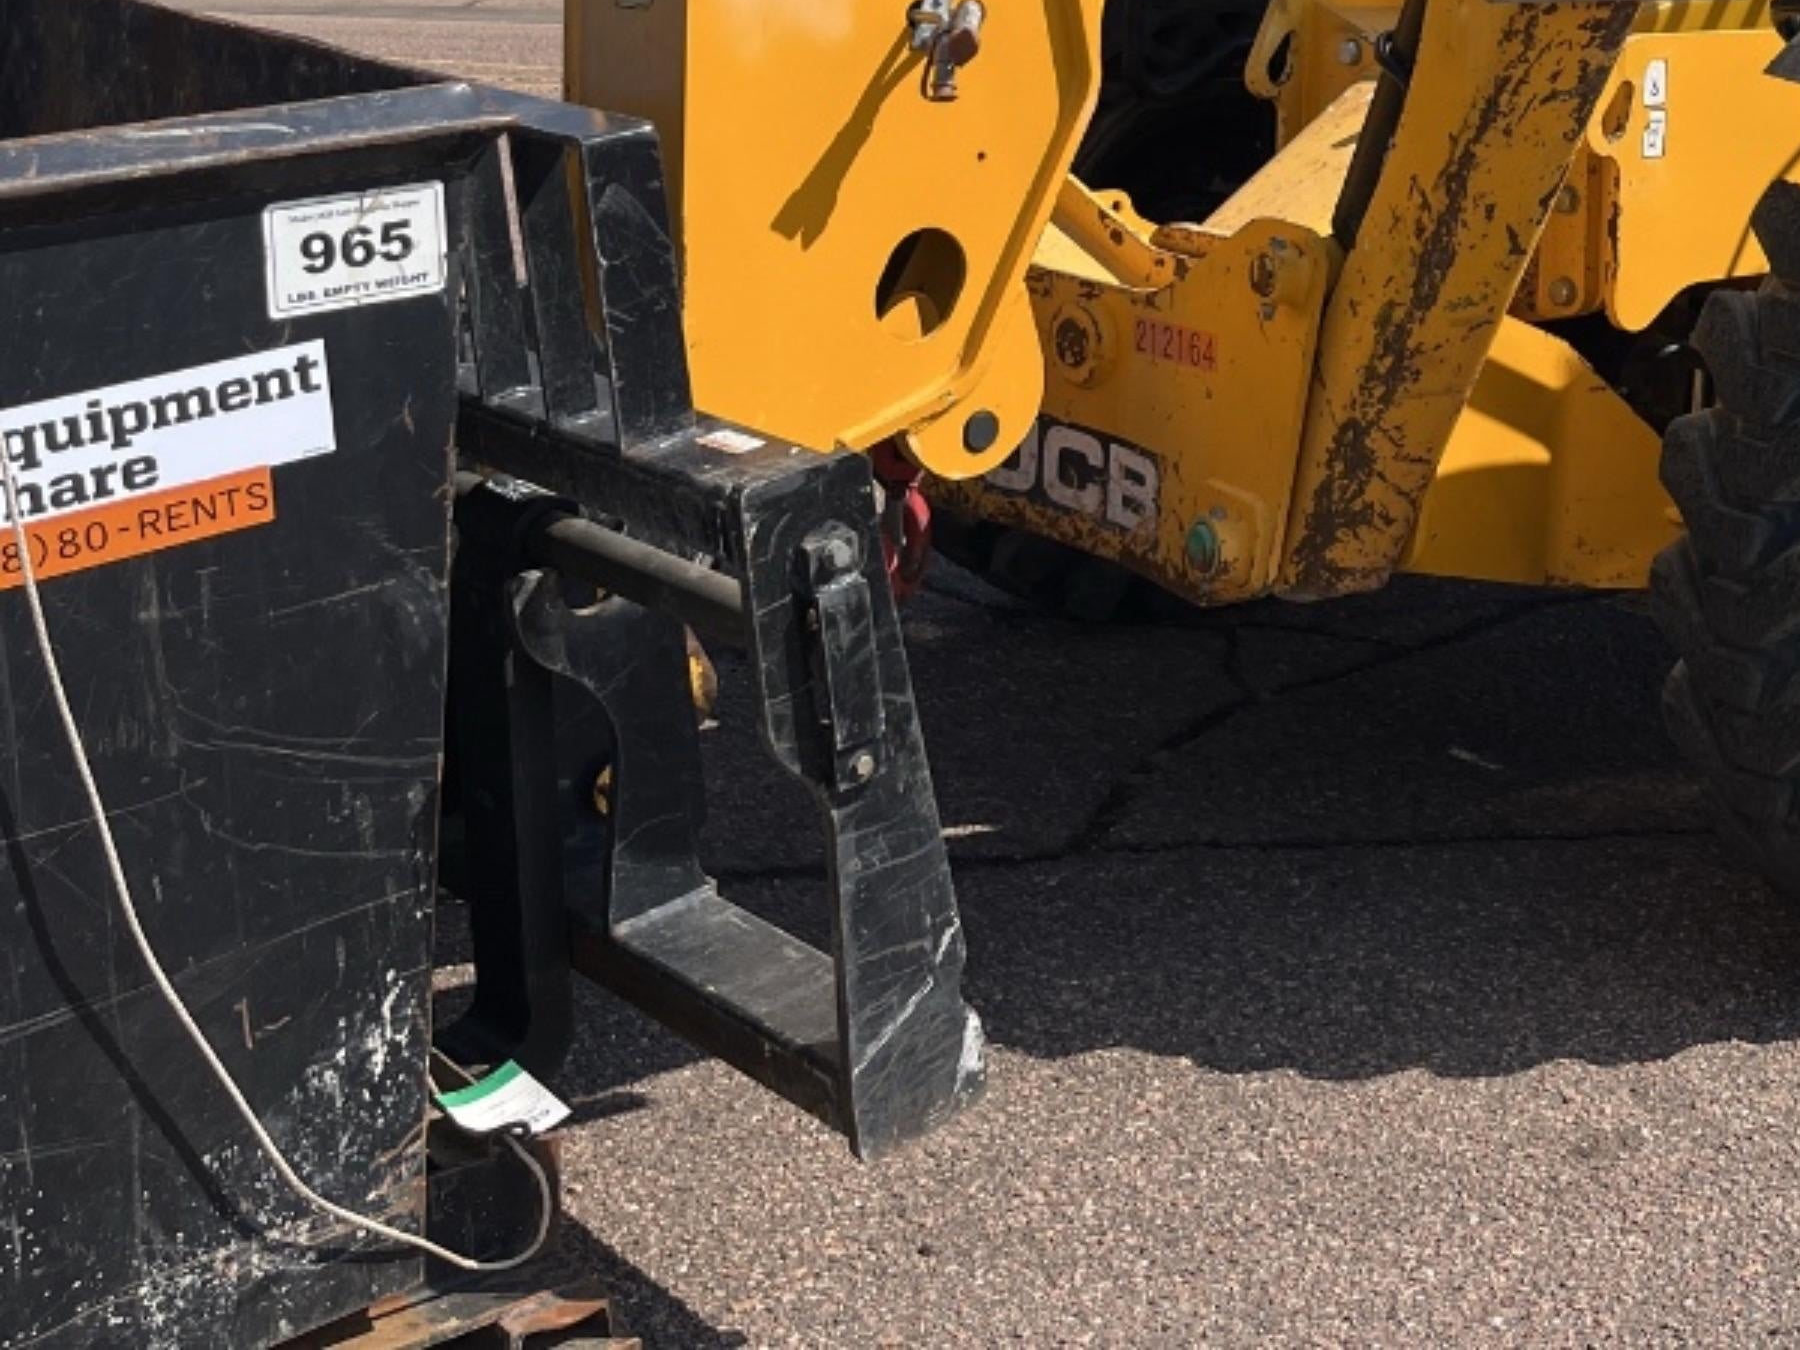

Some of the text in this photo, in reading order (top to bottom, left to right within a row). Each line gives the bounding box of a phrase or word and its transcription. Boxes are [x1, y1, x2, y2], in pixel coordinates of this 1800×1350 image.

[299, 217, 414, 275] 965
[375, 271, 429, 290] WEIGHT
[1135, 319, 1217, 371] 212164
[984, 419, 1158, 531] JCB
